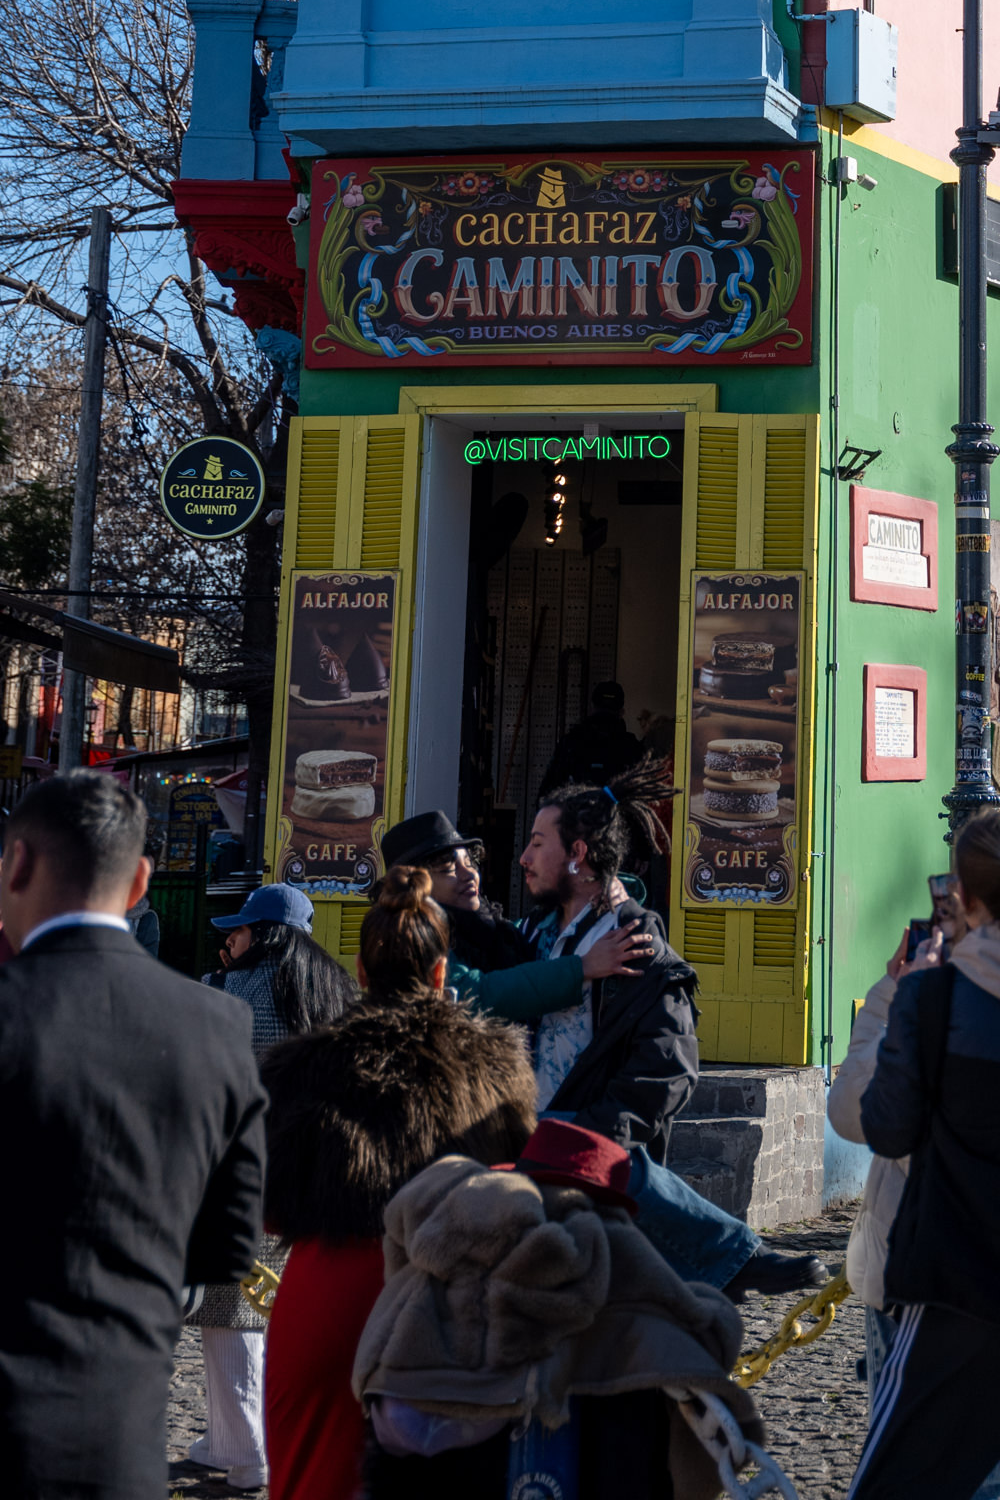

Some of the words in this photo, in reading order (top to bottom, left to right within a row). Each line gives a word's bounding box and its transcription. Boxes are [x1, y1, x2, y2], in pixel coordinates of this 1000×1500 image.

[393, 245, 718, 326] CAMINITO
[468, 325, 558, 339] BUENOS
[566, 324, 633, 338] AIRES
[464, 435, 670, 465] @VISITCAMINITO
[184, 502, 237, 516] CAMINITO
[869, 518, 919, 550] CAMINITO
[302, 592, 389, 609] ALFAJOR
[703, 593, 794, 610] ALFAJOR
[306, 844, 357, 861] CAFE
[714, 850, 768, 868] CAFE
